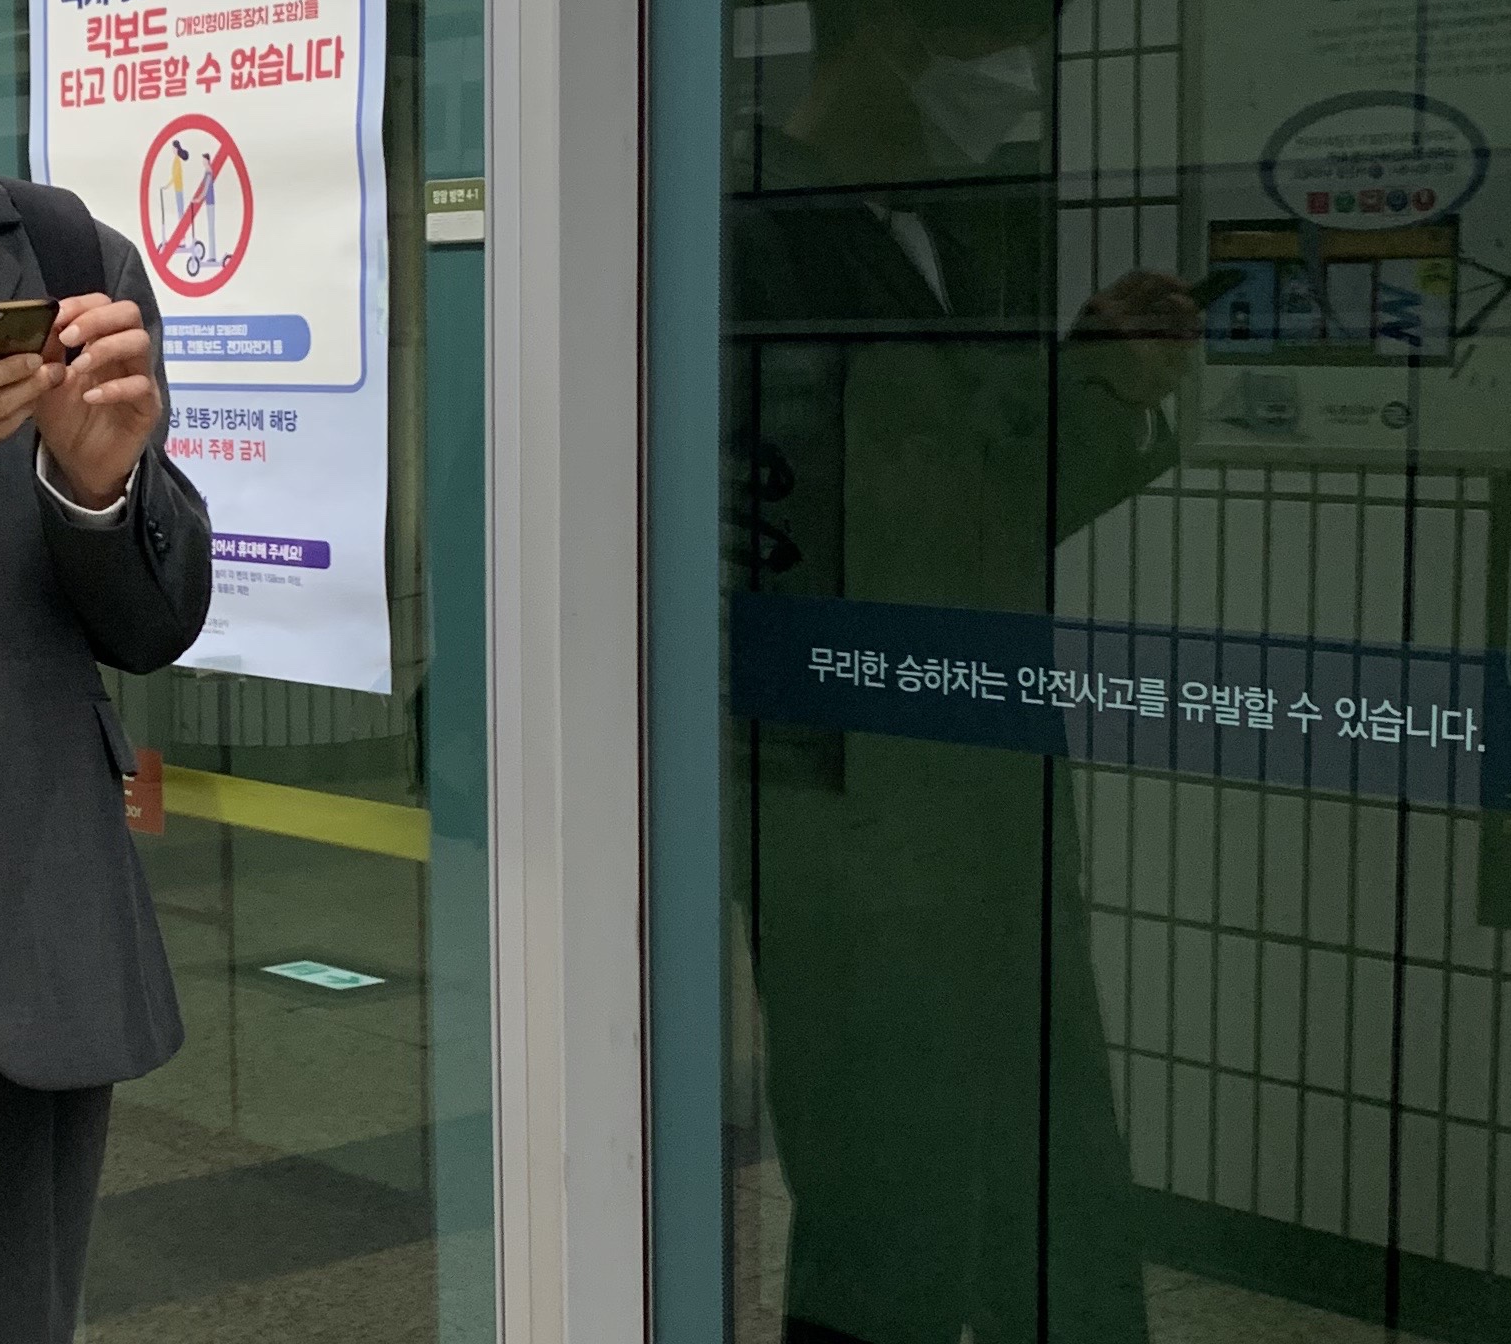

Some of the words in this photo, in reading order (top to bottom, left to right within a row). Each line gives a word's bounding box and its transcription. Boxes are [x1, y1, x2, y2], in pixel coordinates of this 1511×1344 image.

[86, 7, 169, 59] 킥보드
[60, 67, 105, 108] 타고
[112, 55, 190, 102] 이동할
[196, 52, 221, 94] 수
[230, 35, 345, 91] 없습니다
[185, 407, 265, 431] 원동기장치에
[269, 409, 298, 432] 해당
[208, 438, 235, 461] 주행
[239, 439, 267, 462] 금지
[806, 646, 889, 690] 무리한
[895, 657, 1009, 703] 승하차는
[1017, 666, 1170, 719] 안전사고를
[1177, 679, 1278, 730] 유발할
[1287, 691, 1323, 735] 수
[1334, 694, 1487, 754] 있습니다.
